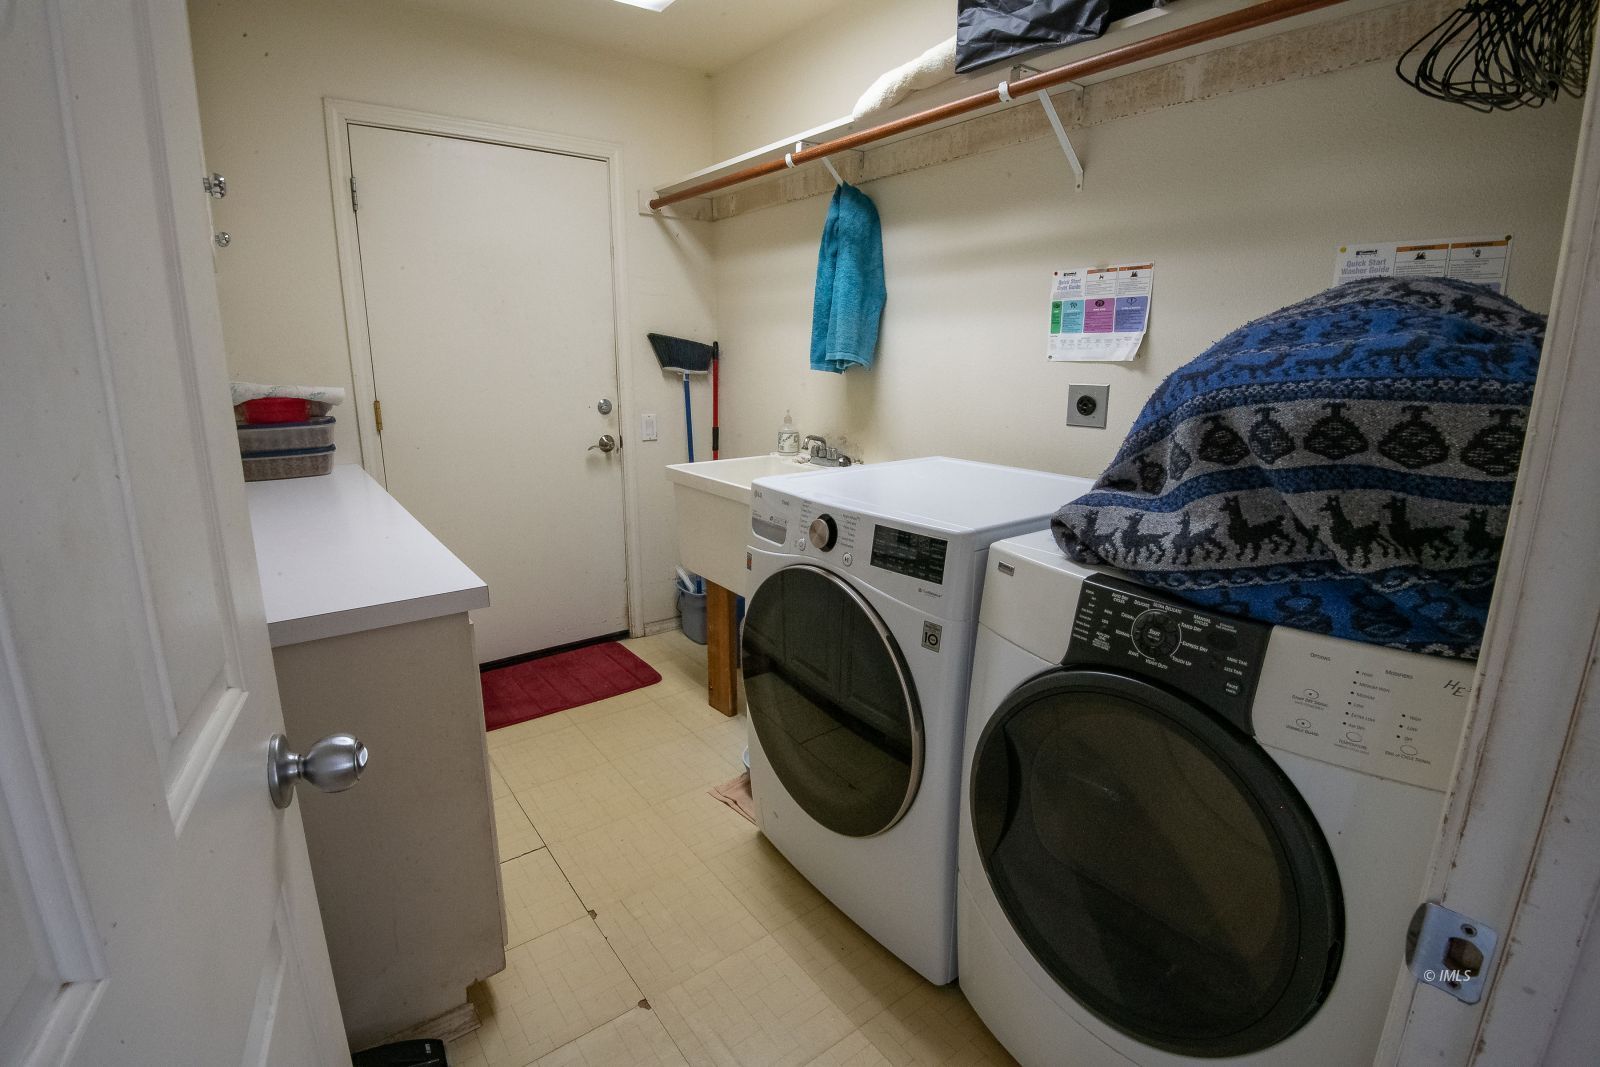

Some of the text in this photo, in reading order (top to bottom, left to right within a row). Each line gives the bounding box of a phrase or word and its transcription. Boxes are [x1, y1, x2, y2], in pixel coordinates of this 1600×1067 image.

[1346, 257, 1387, 268] Quick Start
[1341, 267, 1367, 276] Washer
[1369, 266, 1390, 275] Guide
